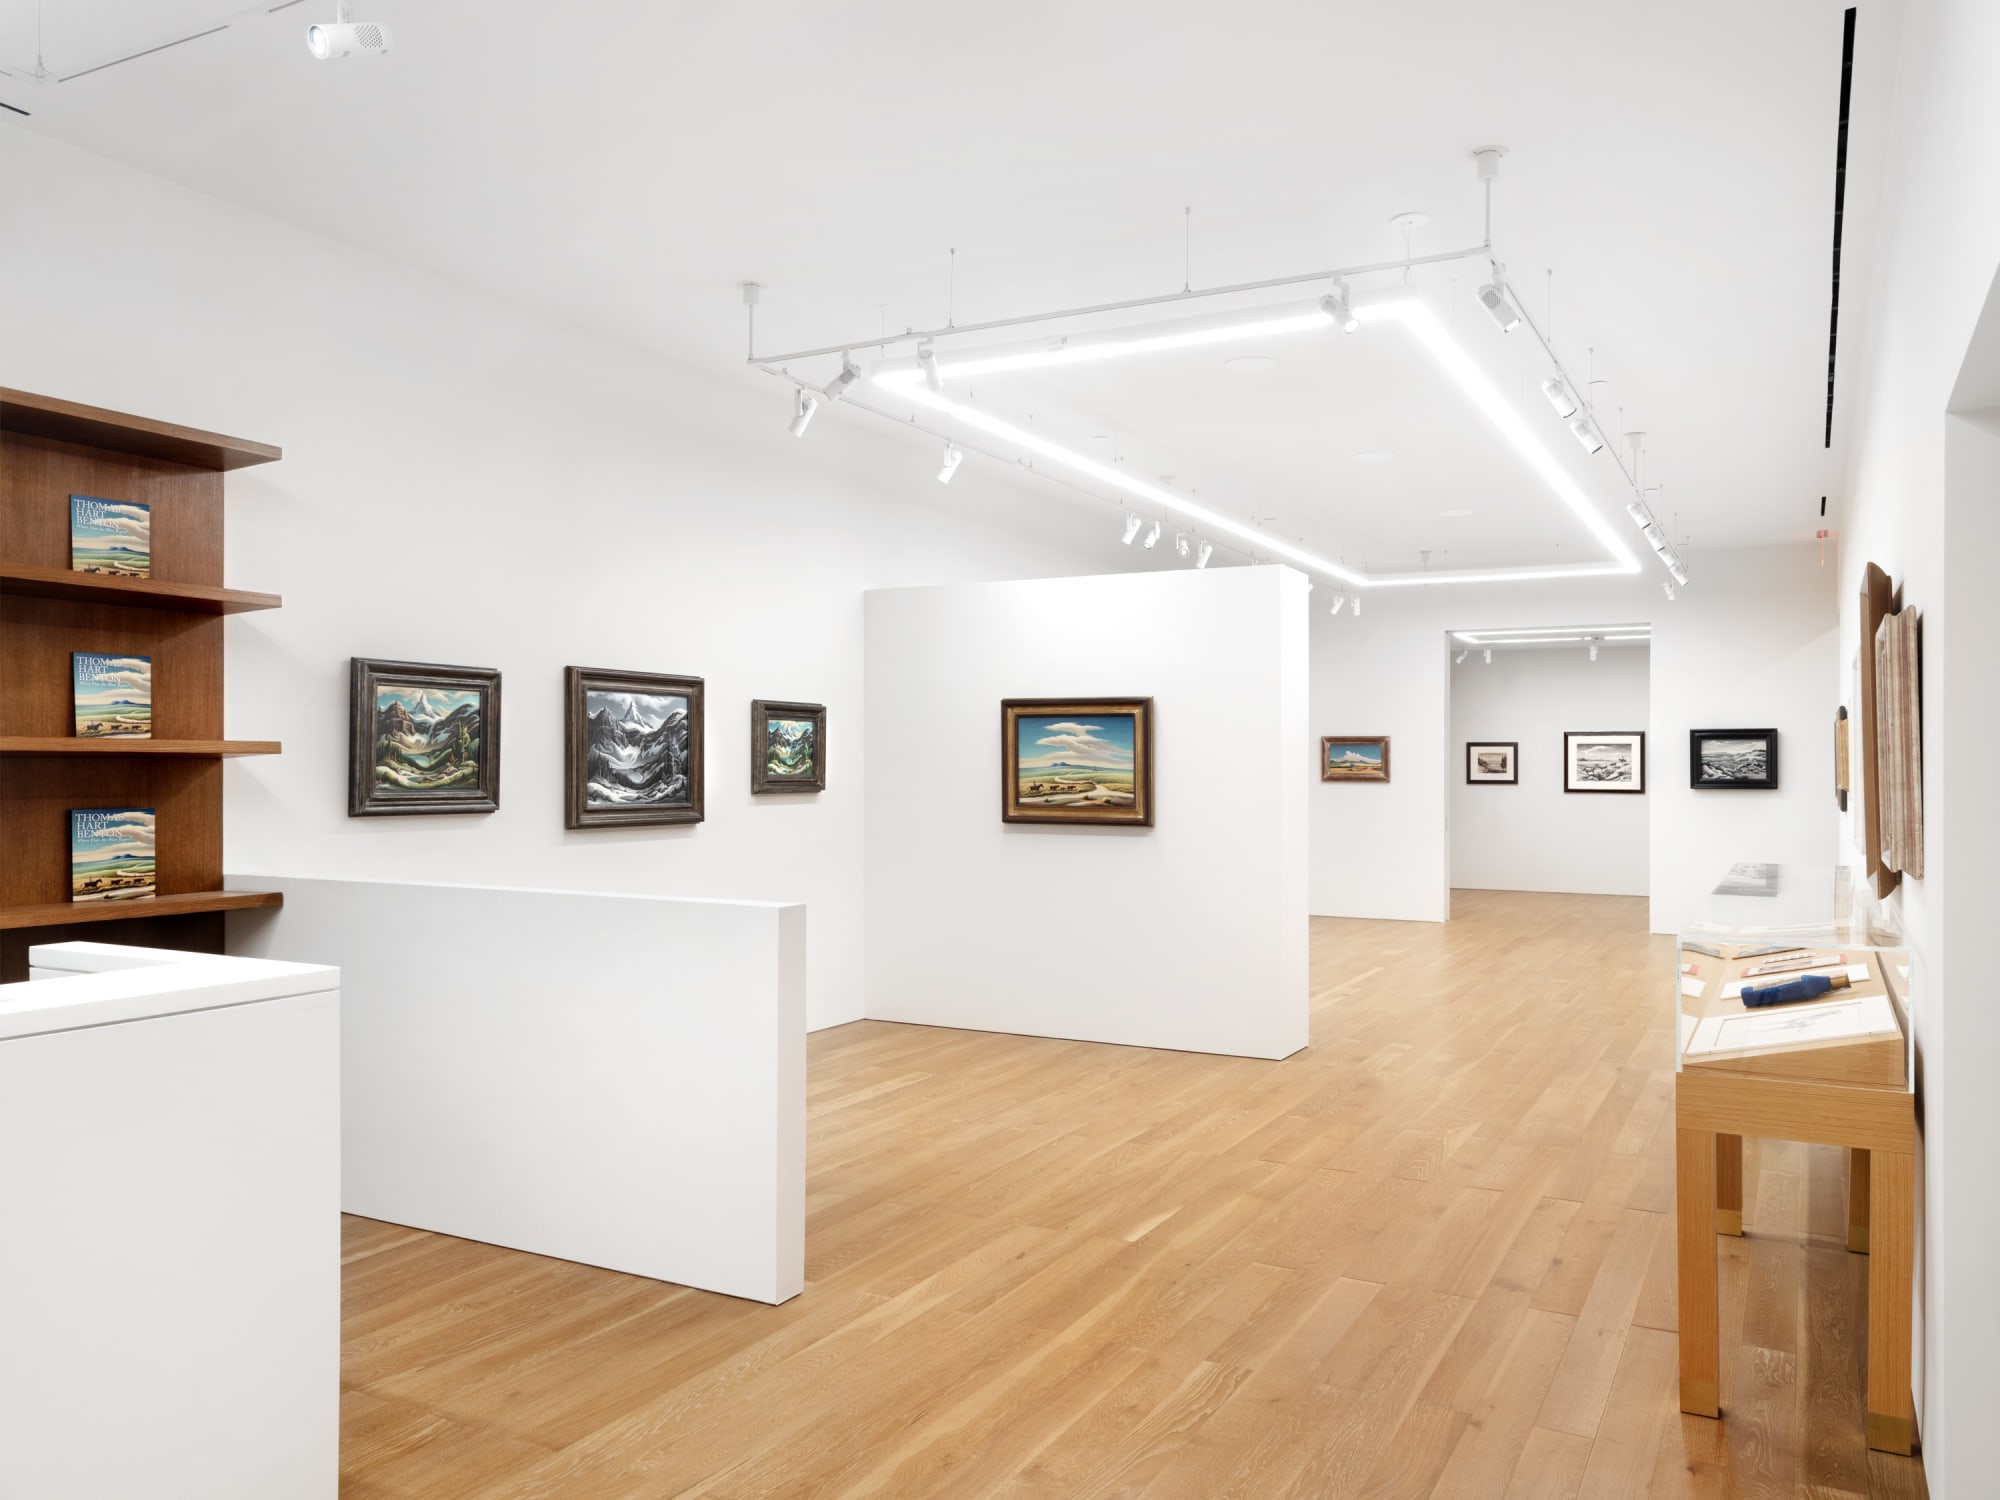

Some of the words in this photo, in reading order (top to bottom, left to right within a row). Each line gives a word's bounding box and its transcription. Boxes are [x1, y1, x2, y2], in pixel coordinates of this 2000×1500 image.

[76, 507, 106, 519] HART
[76, 516, 119, 528] BENTON
[79, 664, 108, 674] HART
[79, 672, 121, 682] BENTON
[77, 821, 109, 830] HART
[77, 829, 122, 839] BENTON
